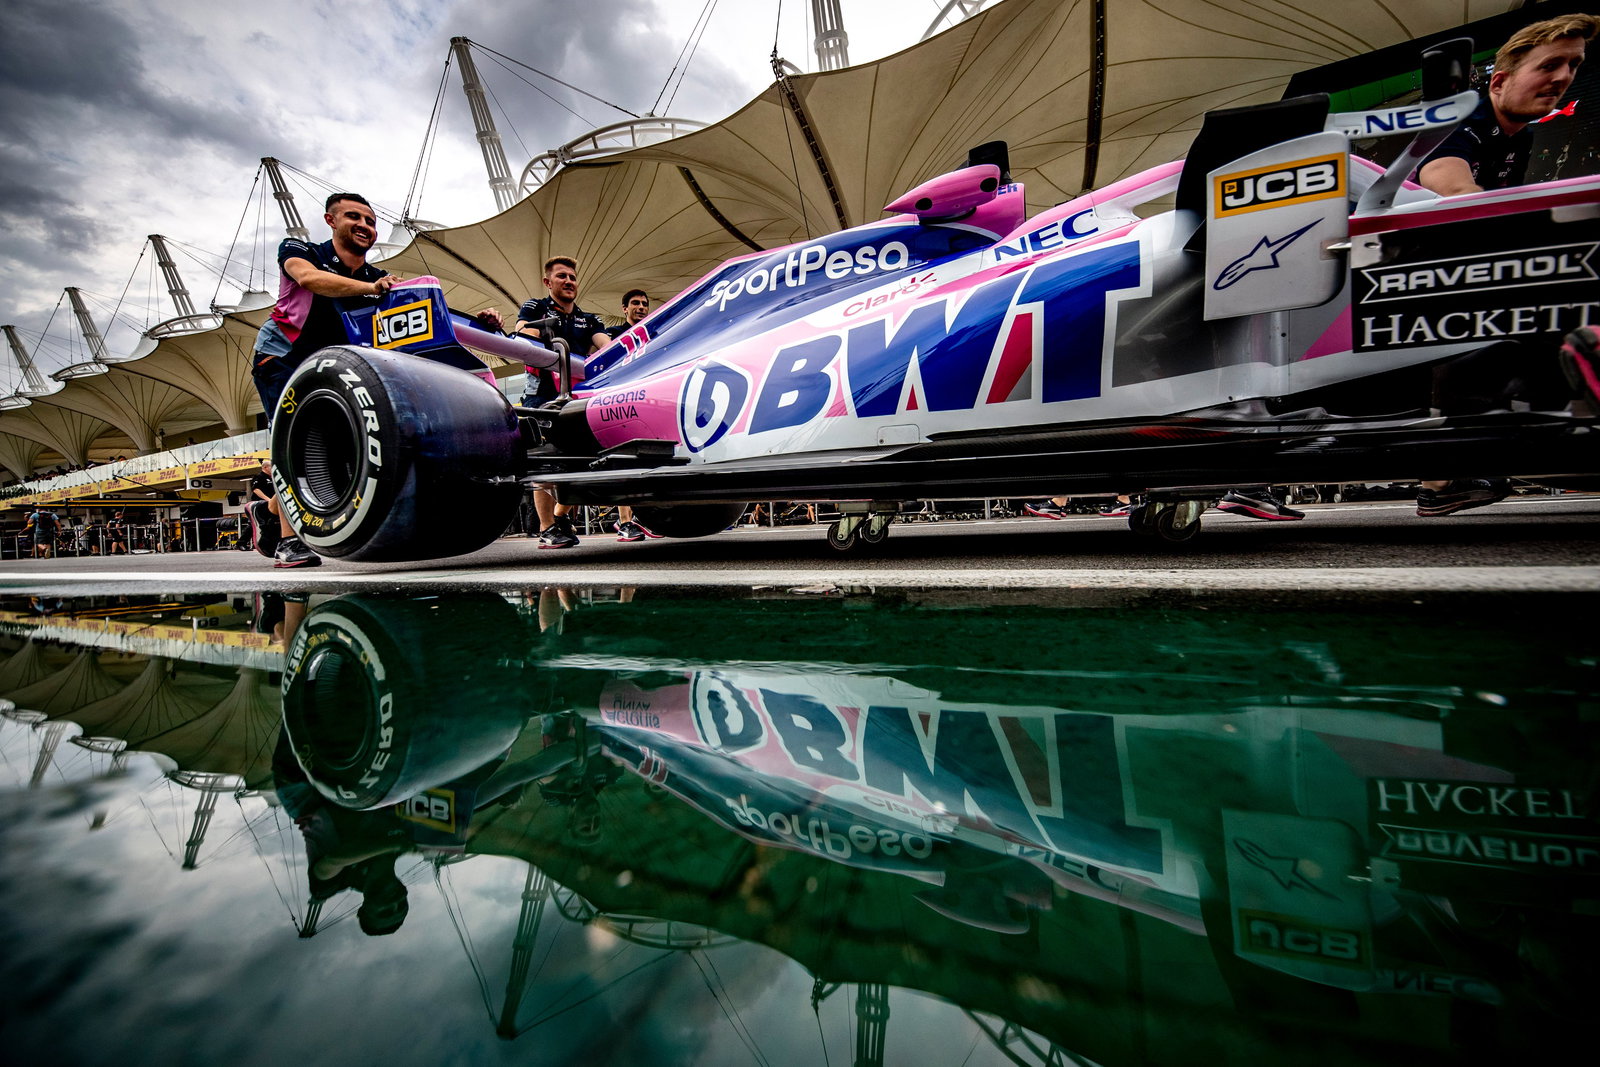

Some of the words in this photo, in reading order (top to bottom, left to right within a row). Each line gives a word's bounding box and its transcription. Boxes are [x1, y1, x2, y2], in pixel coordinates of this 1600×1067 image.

[1366, 101, 1458, 134] NEC
[1224, 163, 1336, 208] JCB
[994, 208, 1099, 262] NEC
[704, 240, 909, 311] sportPesa
[1380, 253, 1584, 294] RAVENOL
[843, 283, 921, 317] Claro
[377, 309, 428, 343] JCB
[748, 240, 1141, 435] BWT
[1361, 302, 1600, 347] HACKETT
[619, 325, 651, 366] 11
[338, 368, 383, 467] ZERO
[590, 389, 647, 408] Acronis
[599, 404, 639, 422] UNIVA
[191, 480, 212, 489] 08
